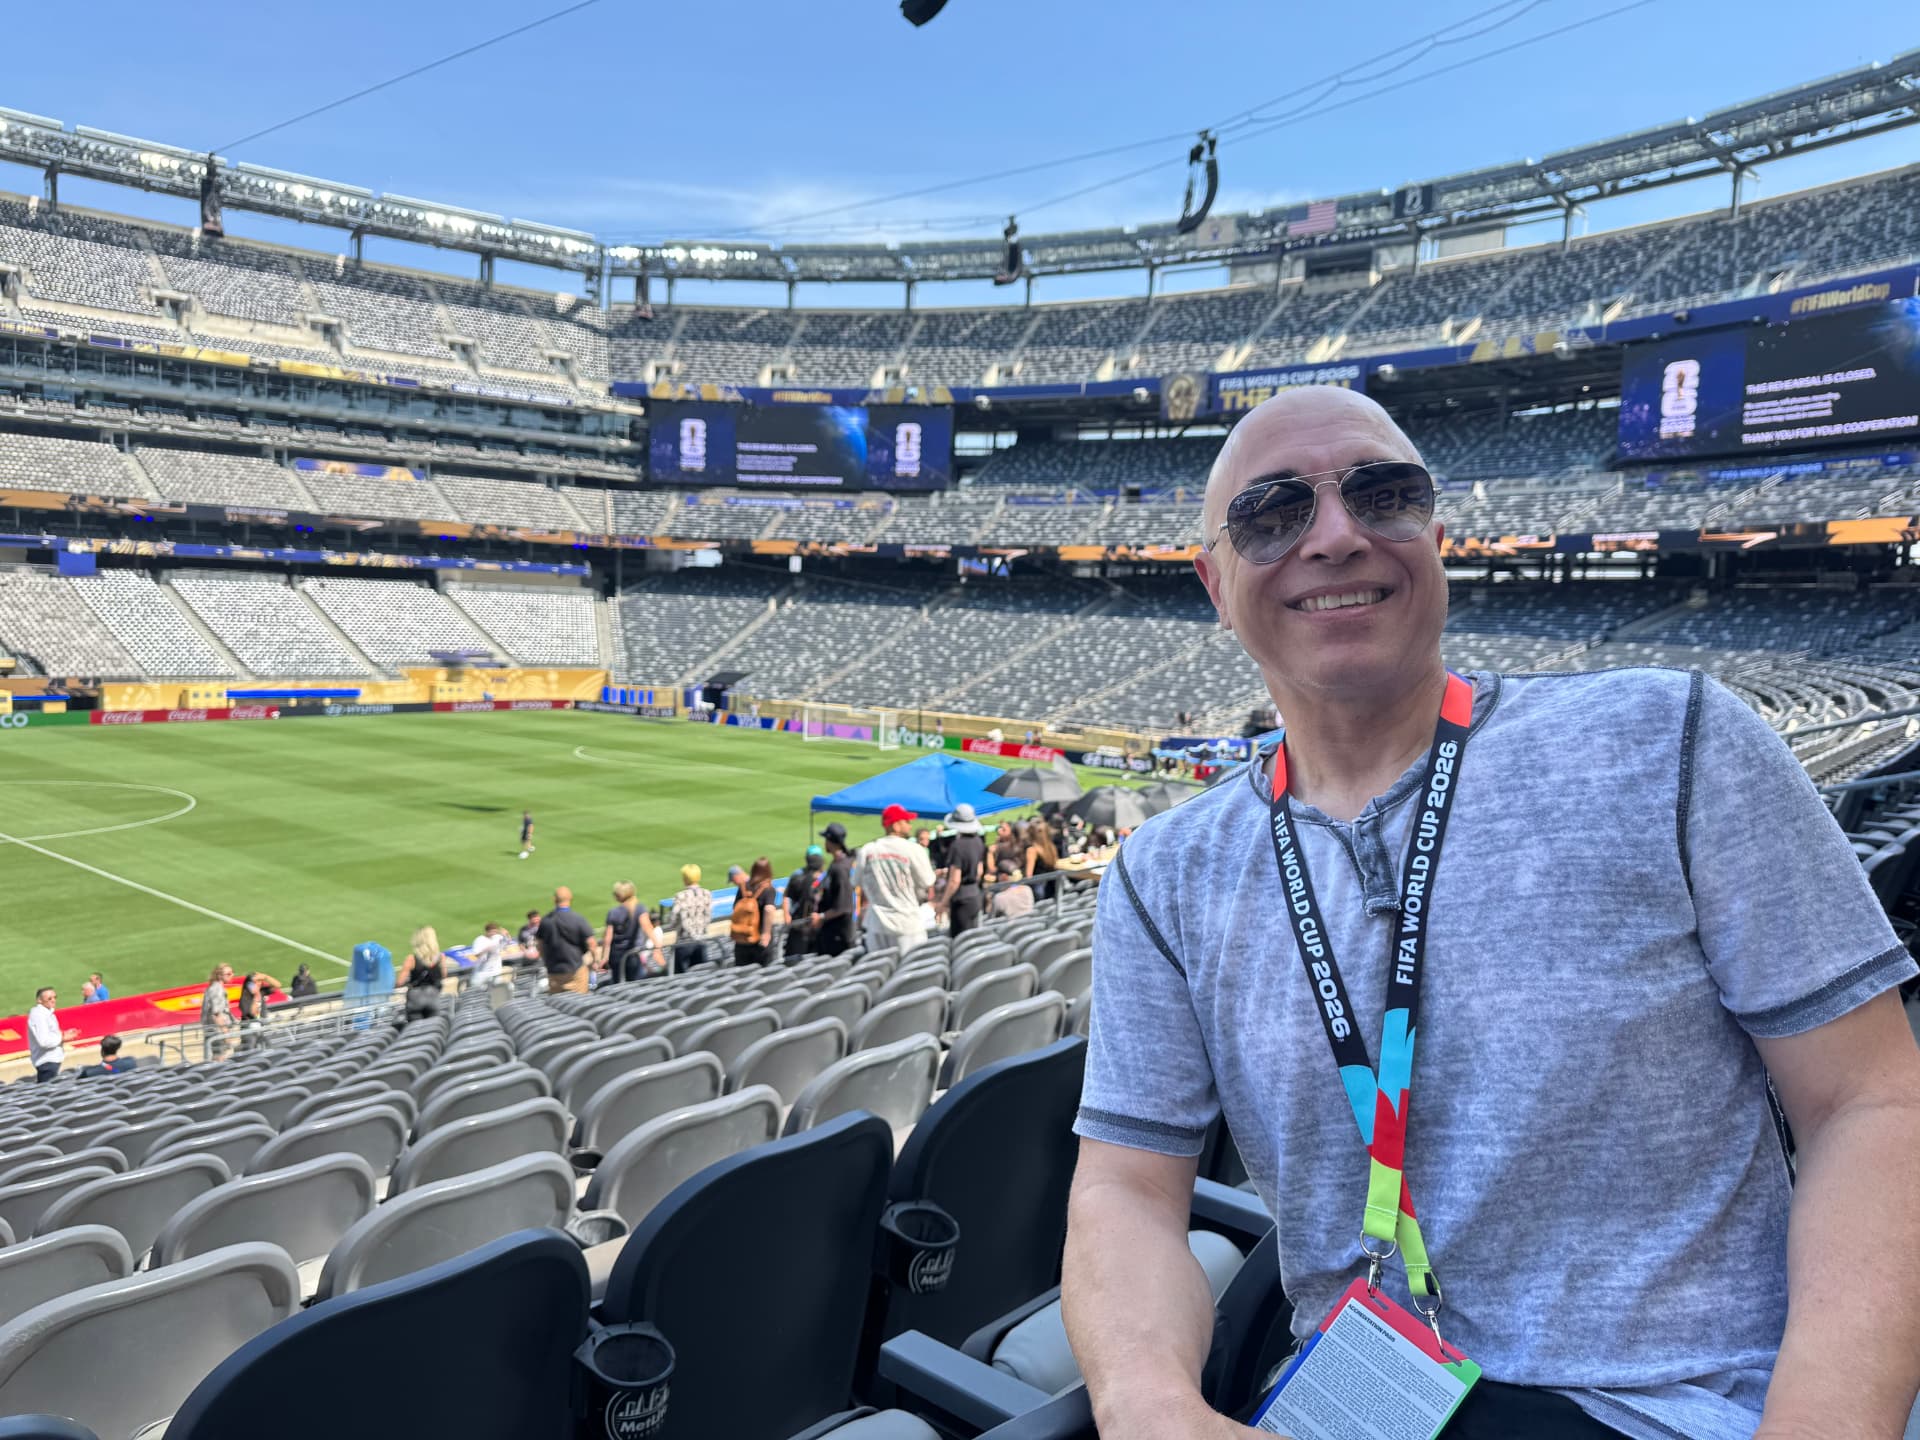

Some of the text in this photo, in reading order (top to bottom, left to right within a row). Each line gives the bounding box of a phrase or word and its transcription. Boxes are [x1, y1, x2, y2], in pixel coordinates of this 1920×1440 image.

[1790, 283, 1890, 314] #FIFAWorldCup
[1219, 366, 1360, 390] FIFA WORLD CUP 2026
[1768, 375, 1822, 392] REHEARSAL
[1219, 387, 1272, 411] THE
[1742, 431, 1773, 445] THANK
[1774, 429, 1795, 441] YOU
[1795, 426, 1816, 439] FOR
[1816, 423, 1843, 437] YOUR
[102, 711, 144, 725] Coca-Cola
[167, 708, 207, 722] Coca-Cola
[1274, 811, 1291, 850] FIFA
[1416, 810, 1440, 852] CUP
[1282, 847, 1310, 915] WORLD
[1402, 855, 1430, 933] WORLD
[1299, 917, 1324, 958] CUP
[1396, 938, 1418, 985] FIFA
